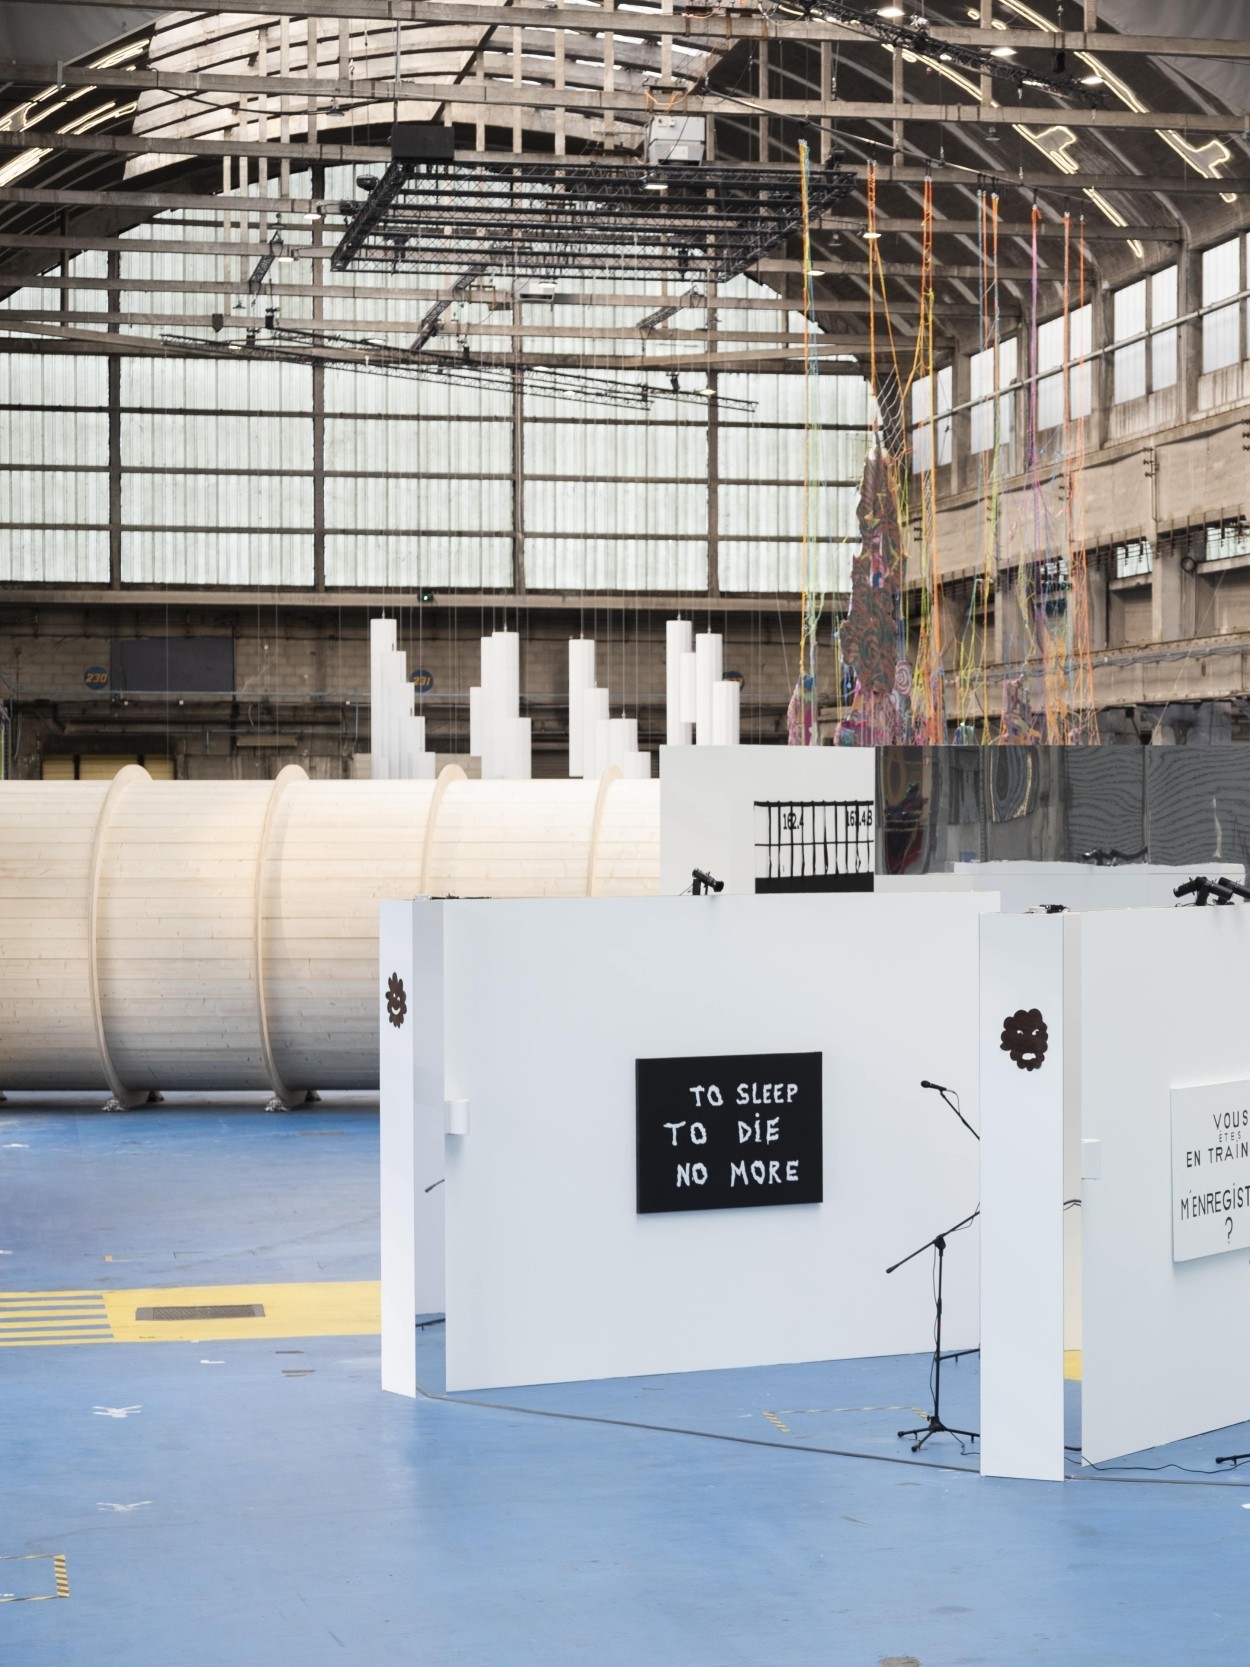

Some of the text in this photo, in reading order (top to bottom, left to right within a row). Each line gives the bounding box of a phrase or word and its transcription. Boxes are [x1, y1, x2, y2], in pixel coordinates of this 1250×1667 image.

[86, 672, 108, 684] 230
[689, 1082, 799, 1107] TO SLEEP
[1212, 1109, 1249, 1130] VOUS
[663, 1120, 708, 1147] TO
[1186, 1150, 1201, 1168] EN
[1207, 1139, 1249, 1164] TRAIN
[676, 1159, 800, 1188] NO MORE
[1225, 1216, 1234, 1245] ?
